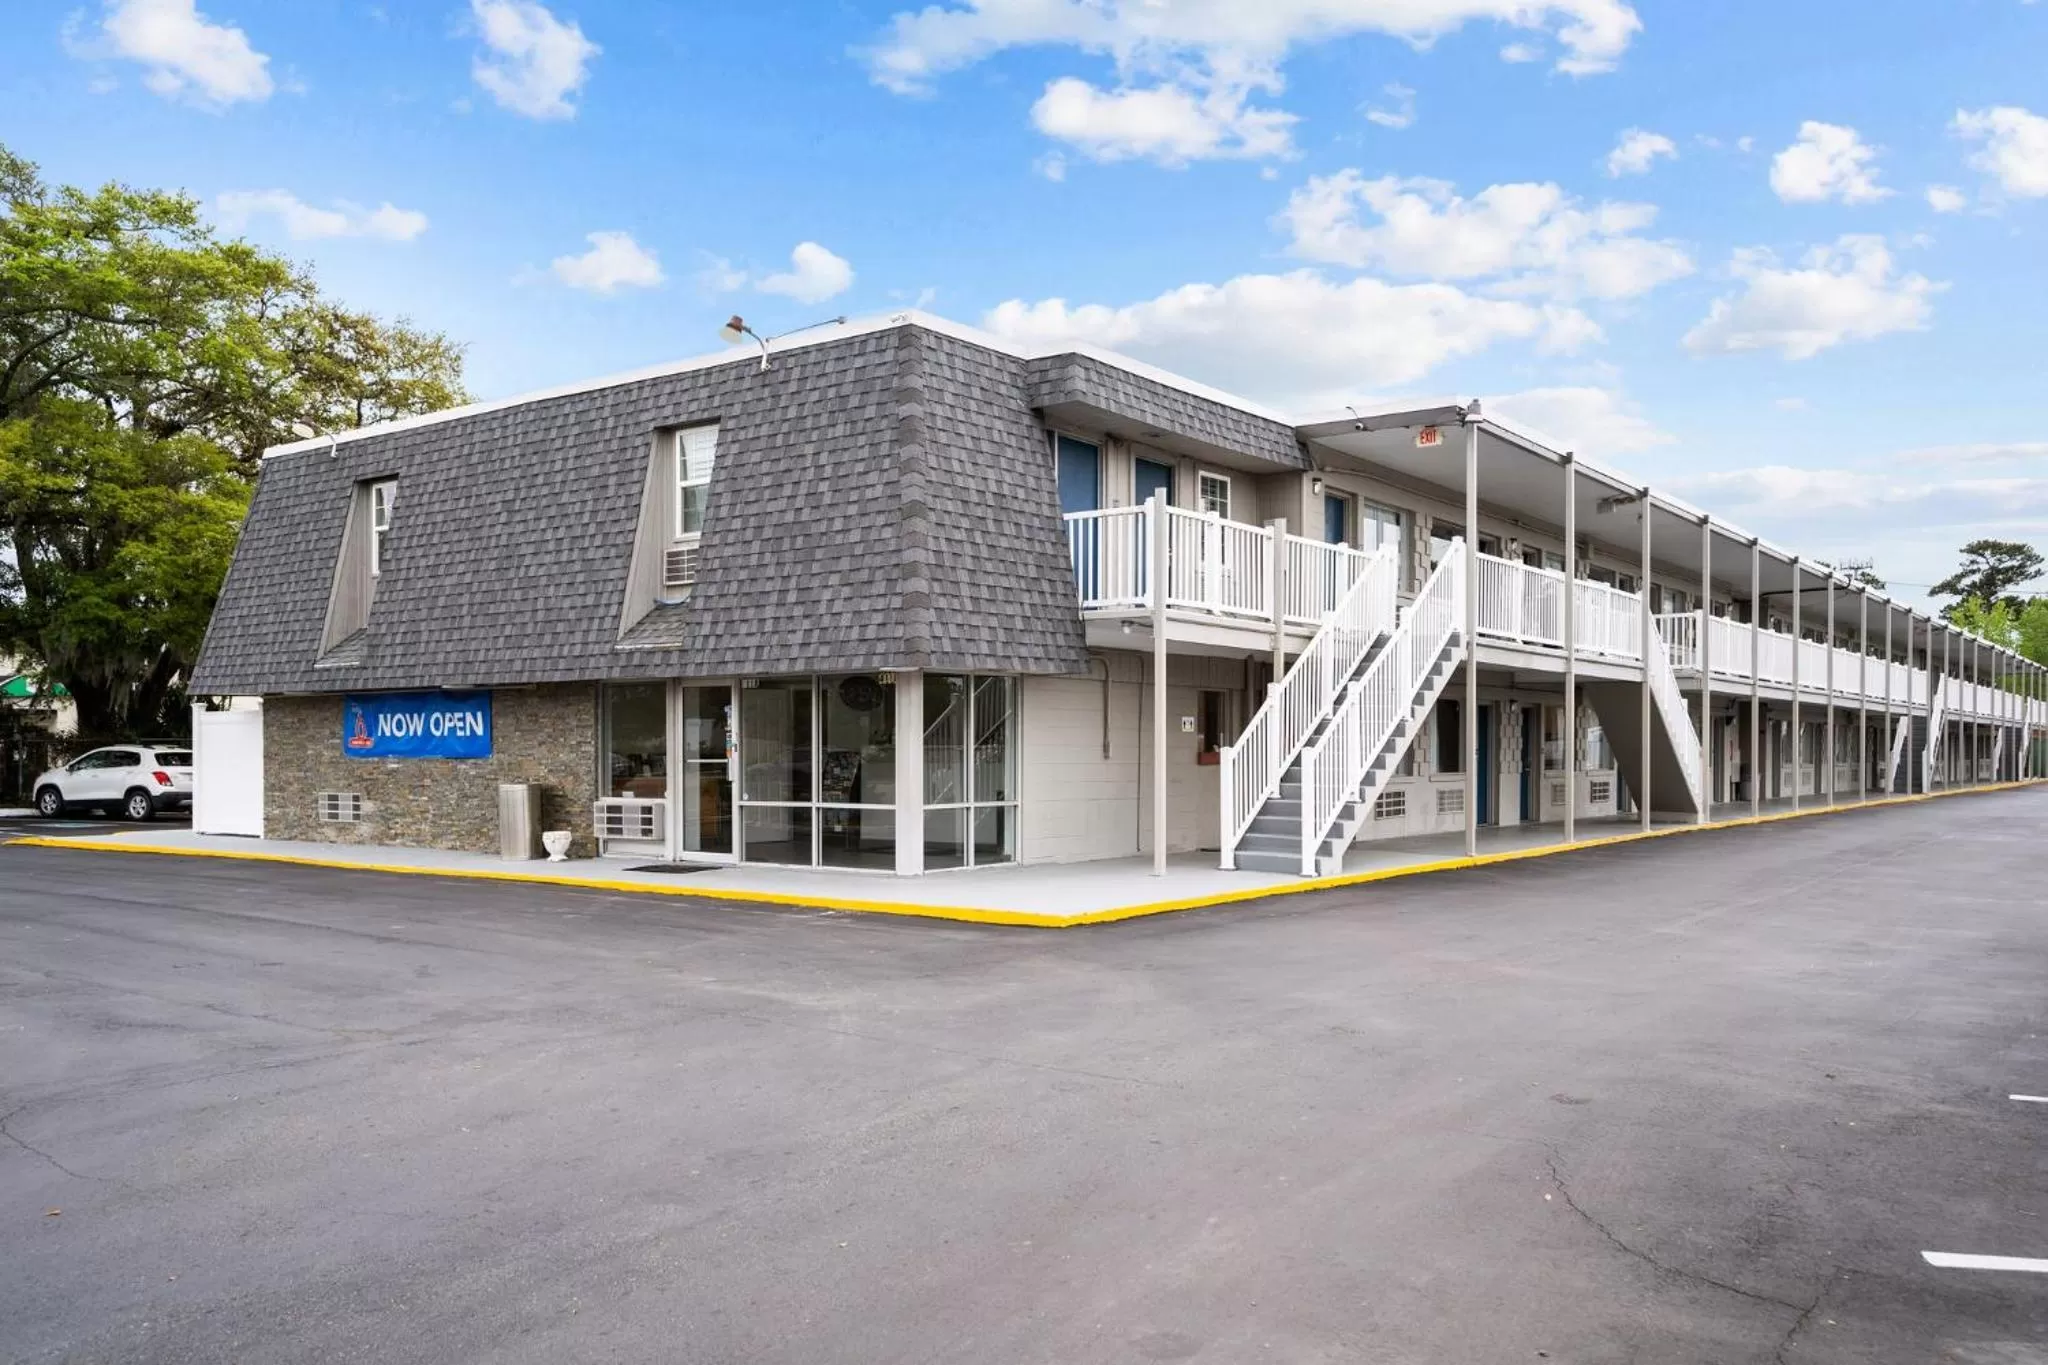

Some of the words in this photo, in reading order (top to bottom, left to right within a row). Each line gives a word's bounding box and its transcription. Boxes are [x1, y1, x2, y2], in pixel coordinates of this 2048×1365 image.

[1420, 429, 1437, 444] EXIT
[378, 712, 425, 737] NOW
[430, 711, 484, 737] OPEN
